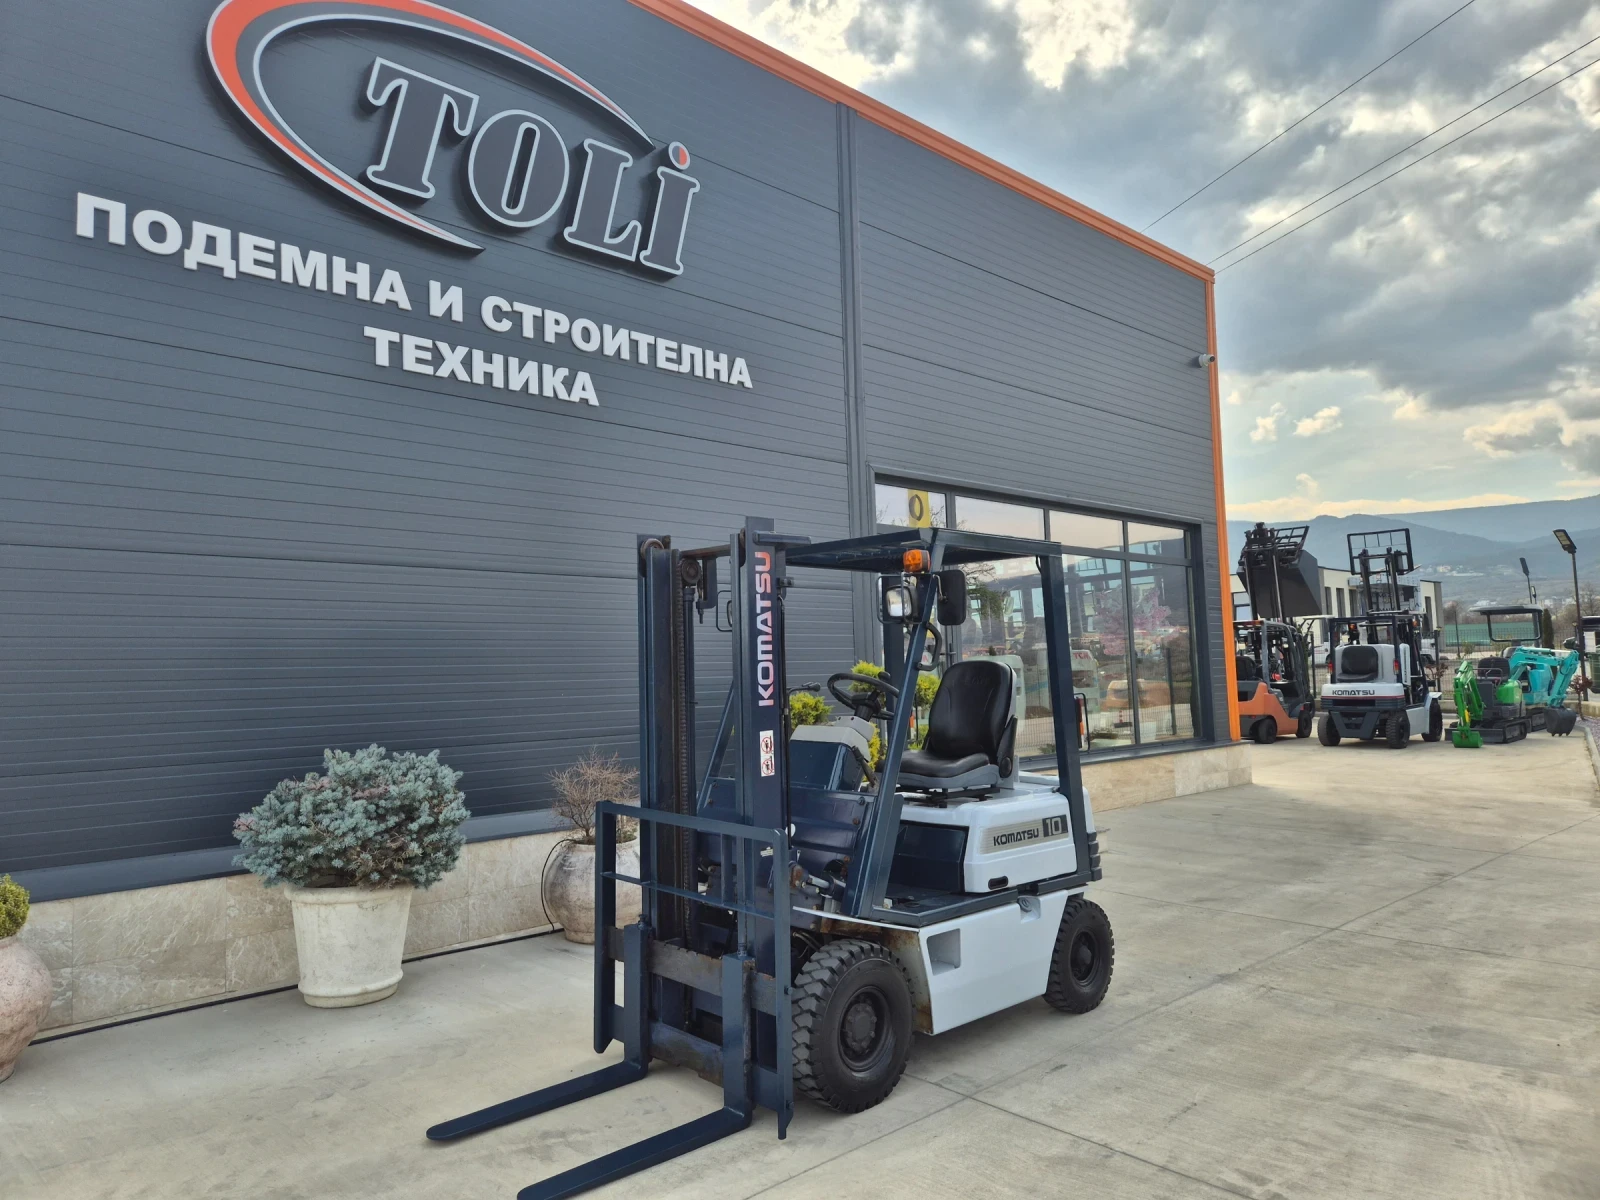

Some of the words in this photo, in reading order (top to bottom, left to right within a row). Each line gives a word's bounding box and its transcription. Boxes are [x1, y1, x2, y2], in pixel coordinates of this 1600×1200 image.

[75, 192, 412, 311] ПОДЕМНА
[428, 279, 464, 323] И
[480, 295, 754, 390] СТРОИТЕЛНА
[363, 325, 600, 407] ТЕХНИКА
[755, 551, 775, 706] KOMATSU
[993, 828, 1039, 846] KOMATSU
[1046, 817, 1062, 836] 10
